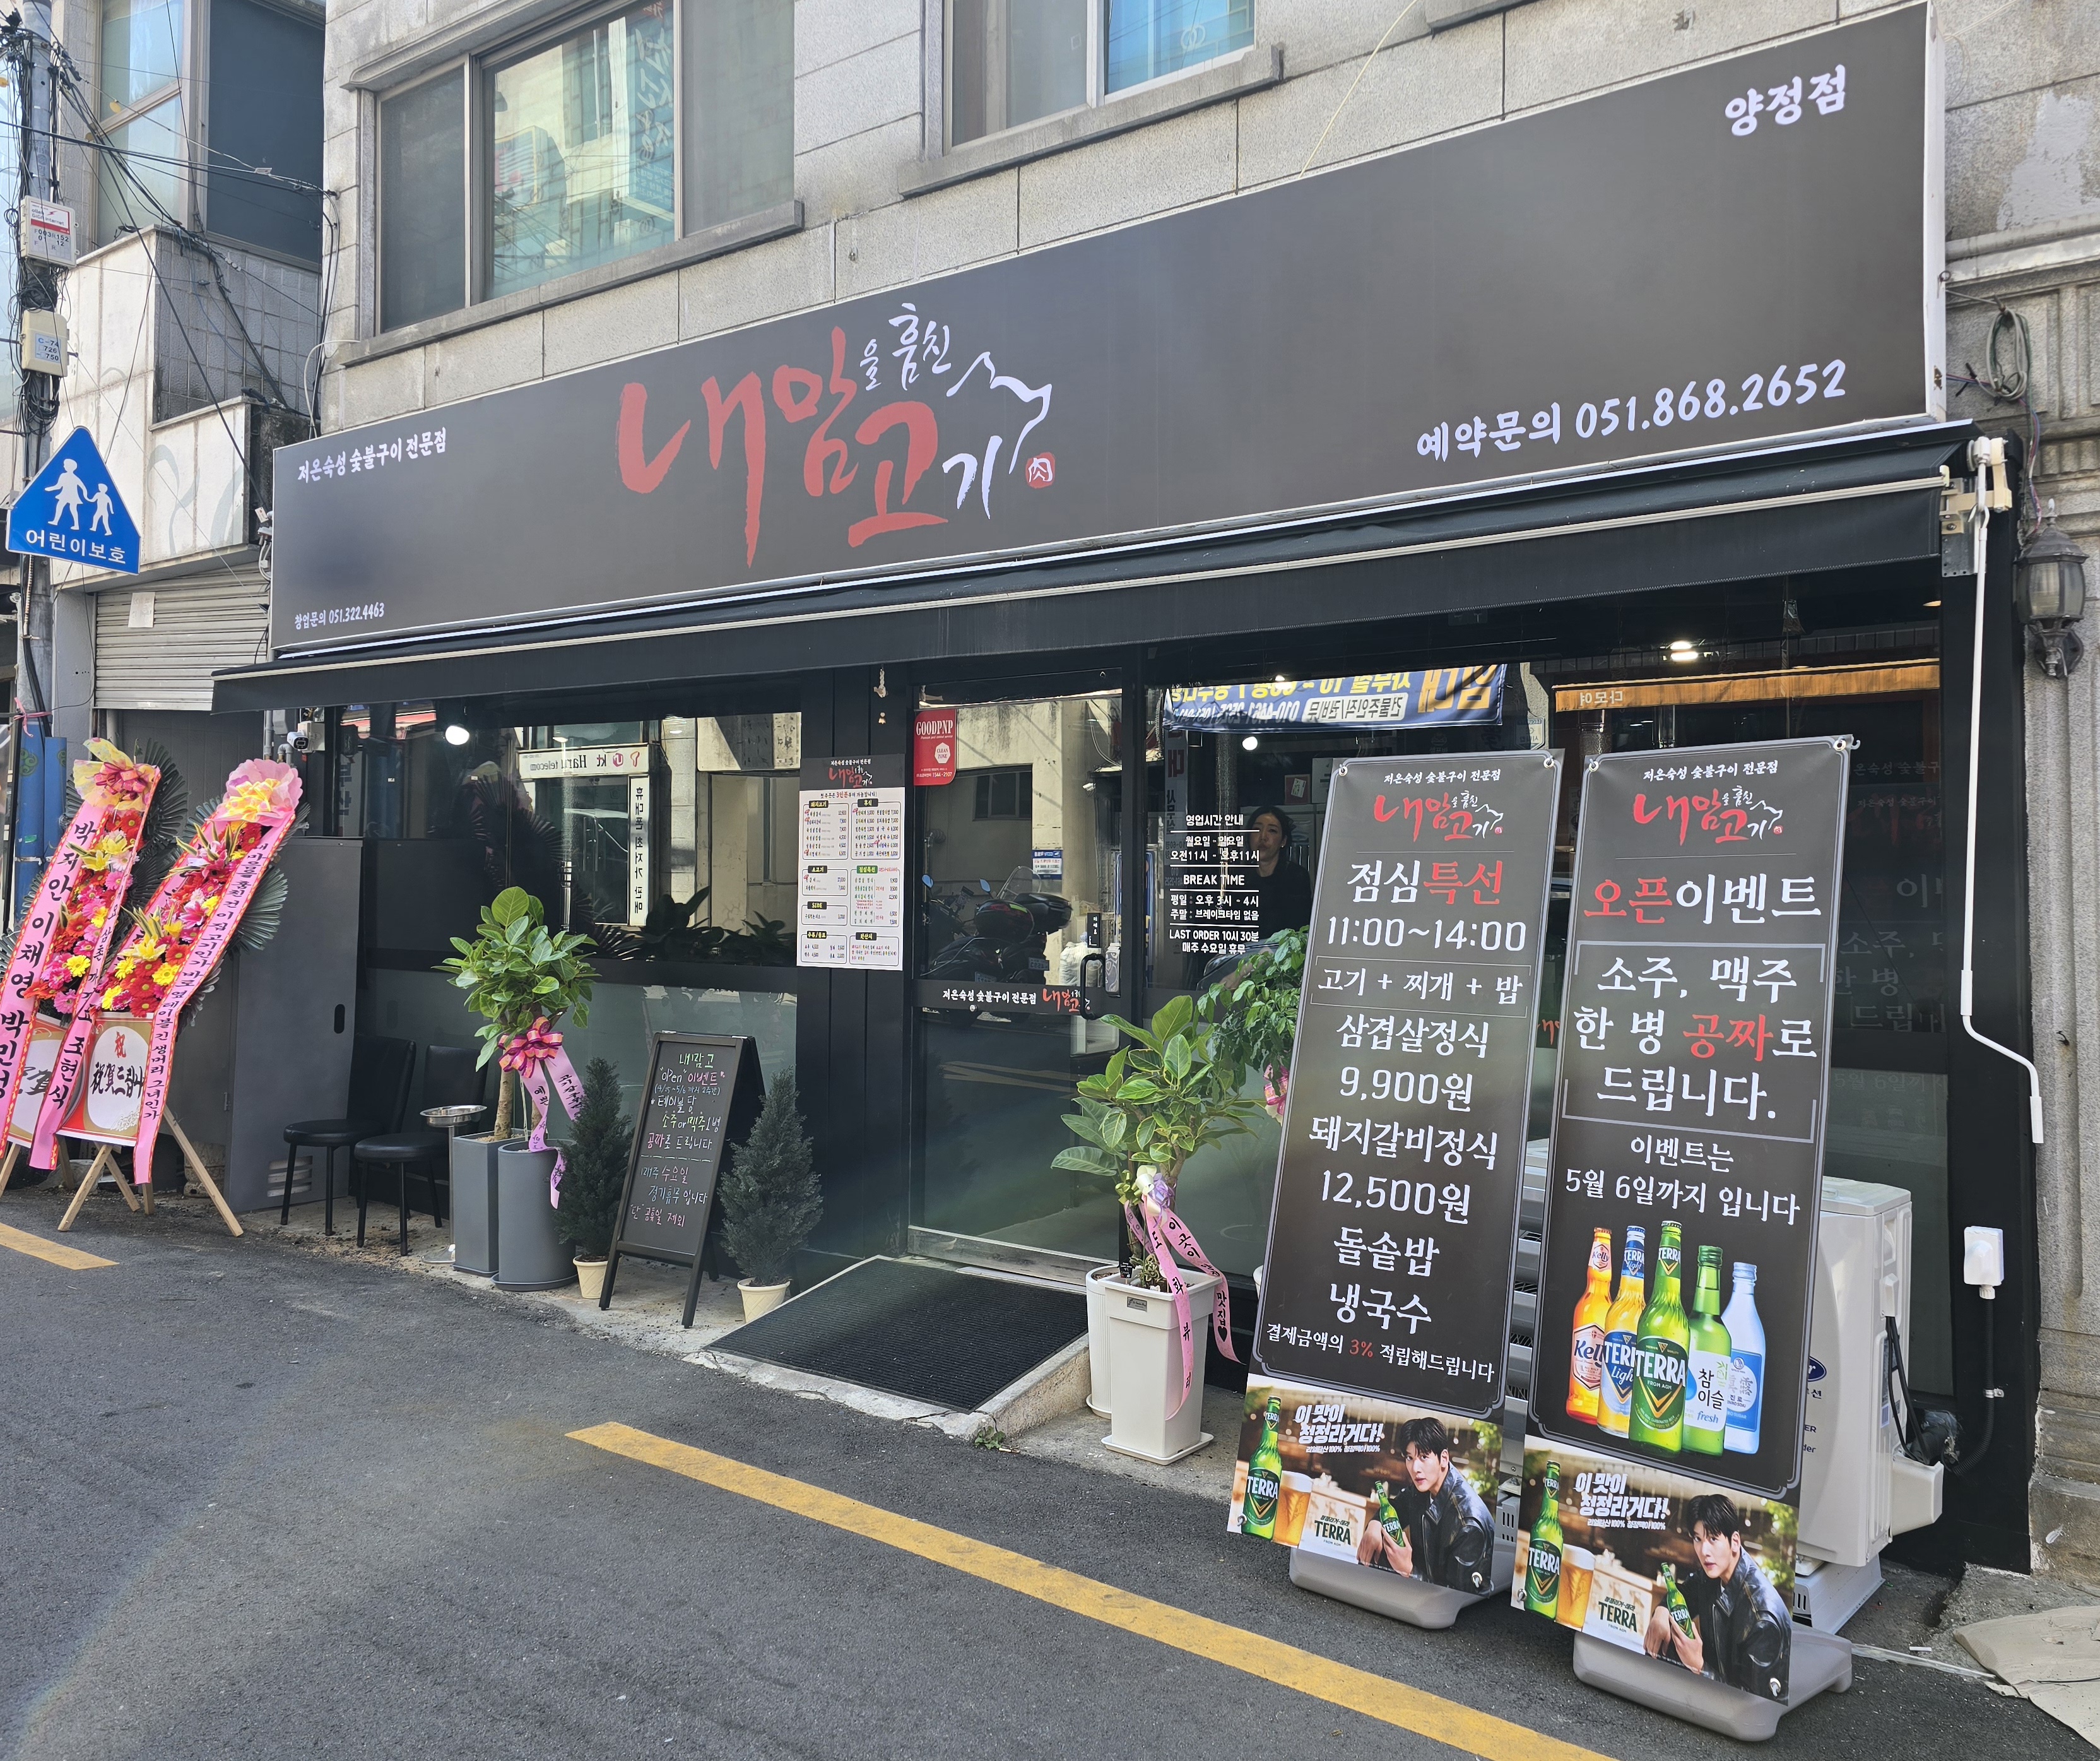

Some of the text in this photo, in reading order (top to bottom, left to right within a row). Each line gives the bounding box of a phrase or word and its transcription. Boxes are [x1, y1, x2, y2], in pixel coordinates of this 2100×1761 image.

[1725, 64, 1846, 136] 양정점
[44, 345, 57, 353] 726
[45, 353, 59, 361] 750
[888, 303, 952, 391] 훔친
[1417, 359, 1846, 461] 예약문의 051.868.2652
[298, 427, 447, 484] 저온숙성 숯불구이 전문점
[25, 528, 127, 565] 어린이보호
[295, 601, 385, 631] 창업문의 051.322.4463
[916, 720, 953, 736] GOODPNP
[1384, 768, 1501, 785] 저온숙성 숯불구이 전문점
[1643, 759, 1779, 782] 저온숙성 숯불구이 전문점
[1185, 814, 1244, 826] 영업시간 안내
[1185, 835, 1211, 848] 월요일
[1170, 849, 1259, 862] 오전11시 오후11시
[1183, 874, 1218, 886] BREAK
[1220, 874, 1245, 886] TIME
[1347, 859, 1503, 905] 점심특선
[1171, 894, 1259, 907] 평일 오후 3시 4시
[1583, 872, 1822, 925] 오픈이벤트
[1170, 909, 1259, 922] 주말 브레이크타임 없음
[1169, 929, 1259, 942] LAST ORDER 10시 30분
[1328, 915, 1526, 952] 11:00~14:00
[1182, 942, 1246, 955] 매주 수요일 휴무
[143, 852, 267, 1120] 마음을 훔친 건 이 집 고기인가 바로 옆 테이블 긴 생머리 그녀인가
[1318, 968, 1523, 1005] 고기 찌개 밥
[1597, 956, 1798, 1004] 소주, 맥주
[942, 988, 1037, 1005] 저온숙성 숯불구이 전문점
[114, 1031, 127, 1058] 祝
[1335, 1013, 1490, 1059] 삼겹살정식
[1573, 1005, 1614, 1051] 한
[1630, 1009, 1665, 1055] 병
[1682, 1013, 1818, 1062] 공짜로
[687, 1071, 718, 1086] 이벤트
[1339, 1066, 1473, 1113] 9,900원
[658, 1094, 697, 1113] 테이블 당
[1596, 1065, 1777, 1122] 드립니다.
[663, 1113, 677, 1129] 소주
[687, 1115, 705, 1132] 맥주
[1309, 1115, 1498, 1171] 돼지갈비정식
[1630, 1134, 1735, 1173] 이벤트는
[662, 1165, 688, 1184] 수요일
[649, 1185, 707, 1206] 정기휴무 입니다
[1321, 1170, 1471, 1226] 12,500원
[1565, 1168, 1802, 1226] 5월 6일까지 입니다
[645, 1207, 685, 1227] 공휴일 제외
[1333, 1226, 1441, 1278] 돌솥밥
[1592, 1250, 1609, 1262] Kelly
[1624, 1249, 1644, 1262] TERRA
[1658, 1247, 1681, 1263] TERRA
[1169, 1217, 1201, 1259] 이곳이
[1215, 1289, 1227, 1327] 맛집
[1328, 1283, 1433, 1335] 냉국수
[1265, 1322, 1495, 1384] 결제금액의 3% 적립해드립니다
[1635, 1349, 1686, 1387] TERRA
[1697, 1367, 1714, 1389] 참
[1647, 1380, 1661, 1389] FROM
[1698, 1390, 1725, 1410] 이슬
[1265, 1412, 1279, 1423] TERRA
[1293, 1404, 1346, 1423] 이 맛이
[1697, 1410, 1719, 1425] fresh
[1298, 1423, 1384, 1445] 청정라거다!
[1247, 1476, 1279, 1500] TERRA
[1544, 1478, 1559, 1491] TERRA
[1573, 1473, 1628, 1495] 이 맛이
[1579, 1495, 1670, 1520] 청정라거다!
[1314, 1520, 1351, 1546] TERRA
[1528, 1547, 1560, 1575] TERRA
[1598, 1601, 1637, 1633] TERRA
